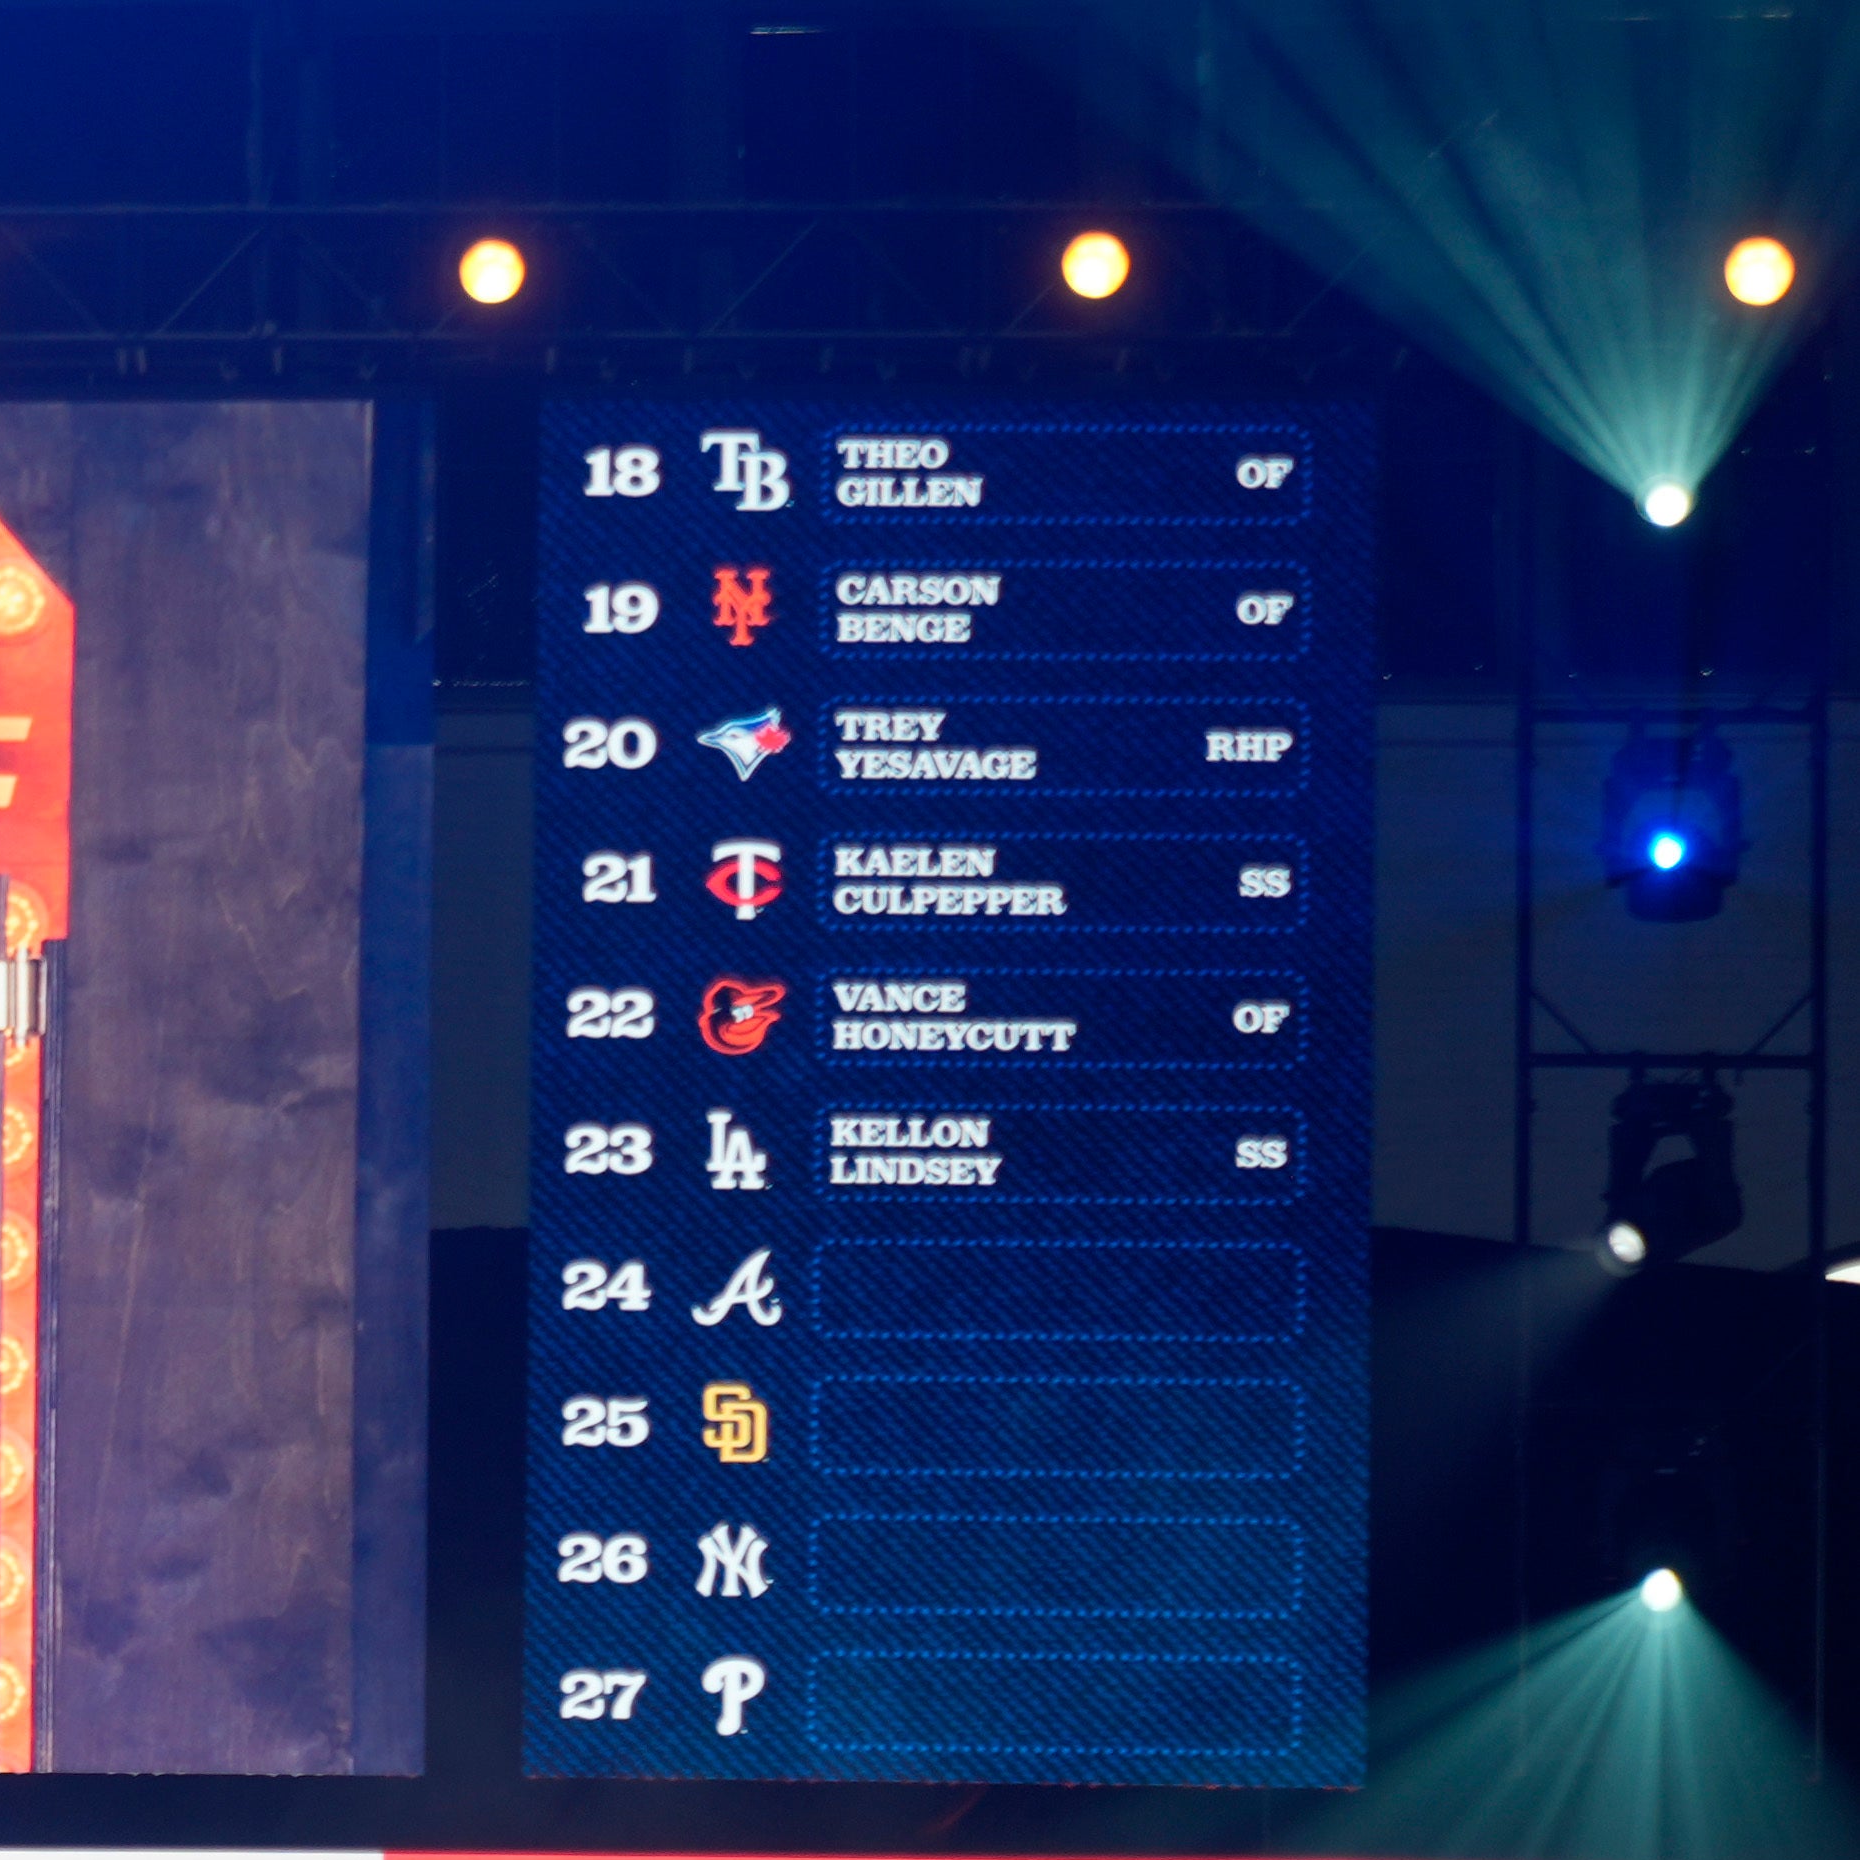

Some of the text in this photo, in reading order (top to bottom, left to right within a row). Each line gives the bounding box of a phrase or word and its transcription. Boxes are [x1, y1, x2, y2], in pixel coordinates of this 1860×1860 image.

[838, 439, 948, 469] THEO
[585, 447, 660, 497] 18
[1237, 459, 1292, 488] OF
[837, 477, 982, 506] GILLEN
[837, 576, 1000, 605] CARSON
[584, 584, 659, 633] 19
[1237, 595, 1292, 624] OF
[837, 613, 970, 642] BENGE
[835, 712, 945, 741] TREY
[564, 720, 656, 769] 20
[1206, 732, 1292, 761] RHP
[835, 749, 1036, 779] YESAVAGE
[835, 847, 996, 876] KAELEN
[583, 854, 656, 902] 21
[1240, 868, 1290, 897] SS
[834, 885, 1066, 915] CULPEPPER
[833, 983, 965, 1012] VANCE
[567, 989, 654, 1038] 22
[1233, 1005, 1289, 1033] OF
[833, 1021, 1076, 1051] HONEYCUTT
[831, 1117, 990, 1147] KELLON
[565, 1125, 652, 1174] 23
[707, 1110, 766, 1189] LA
[1236, 1140, 1287, 1168] SS
[830, 1156, 1002, 1185] LINDSEY
[563, 1261, 651, 1310] 24
[563, 1397, 649, 1447] 25
[558, 1534, 647, 1583] 26
[560, 1670, 646, 1720] 27
